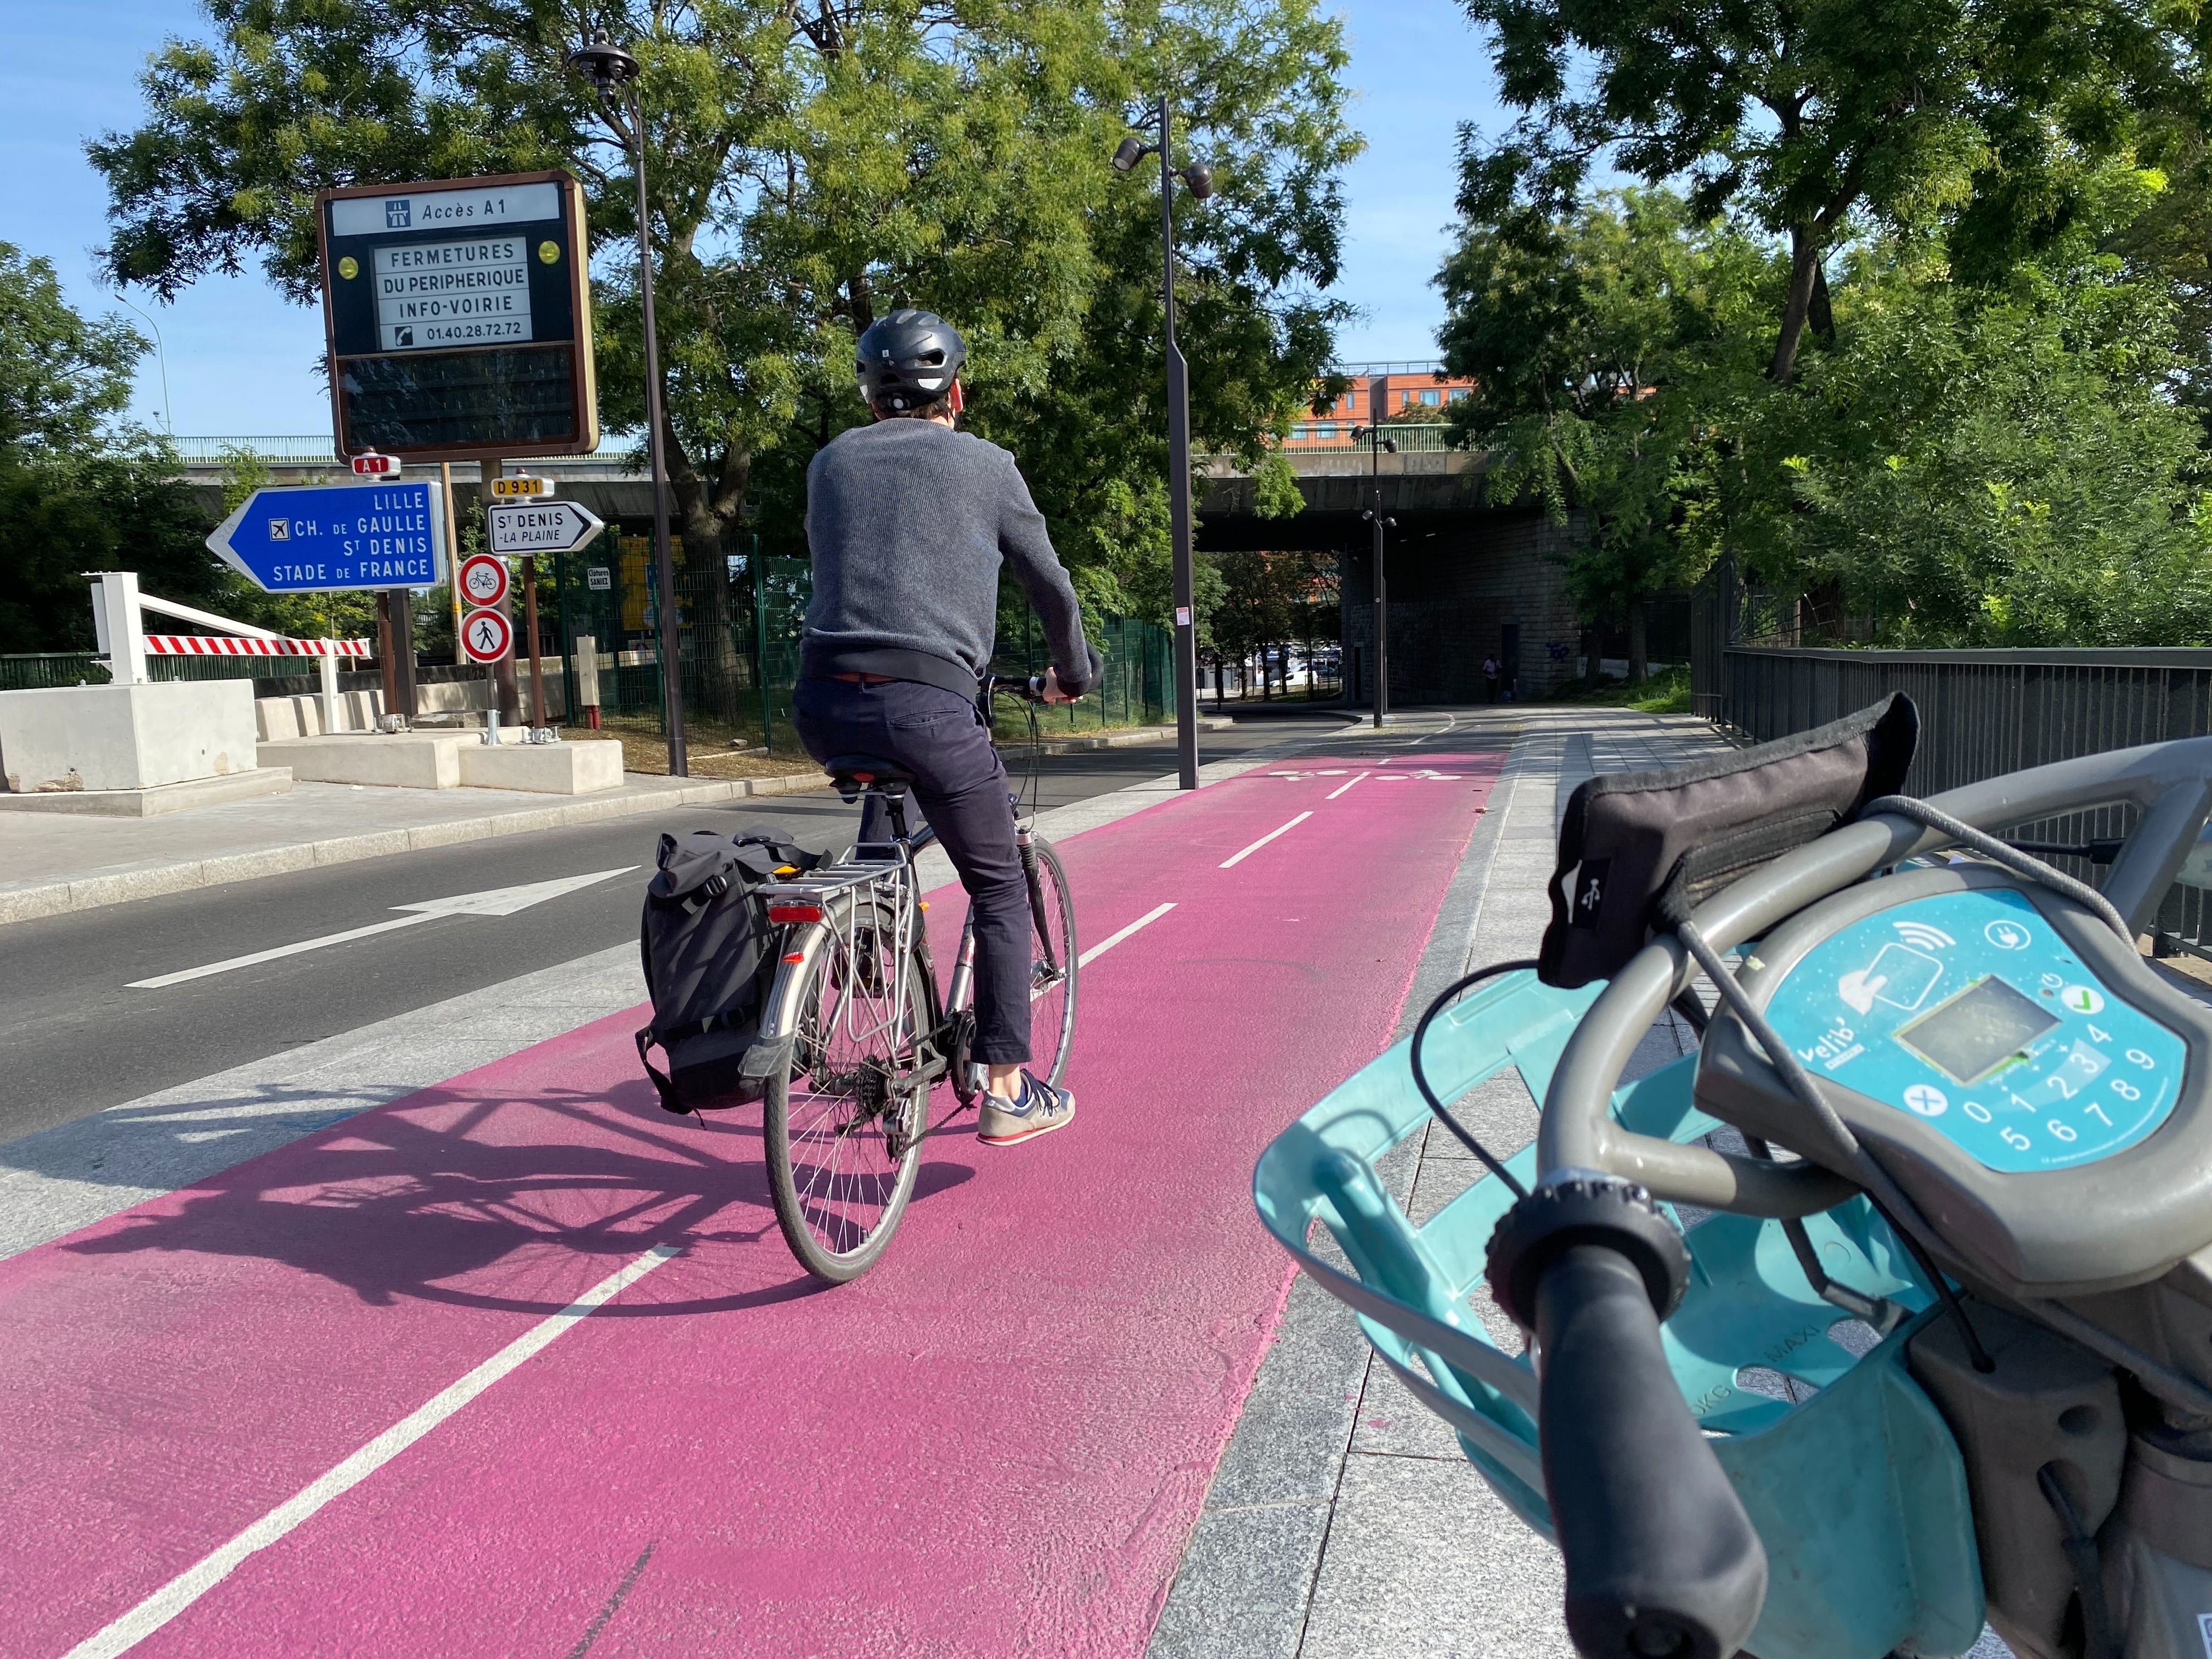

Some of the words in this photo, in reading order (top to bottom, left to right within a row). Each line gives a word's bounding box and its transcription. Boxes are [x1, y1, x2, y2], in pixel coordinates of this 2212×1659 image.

[422, 202, 473, 220] Accès
[391, 243, 514, 267] FERMETURES
[384, 278, 404, 294] DU
[409, 269, 524, 291] PERIPHERIQUE
[400, 296, 512, 318] INFO-VOIRIE
[427, 322, 521, 340] 01.40.28.72.72
[374, 492, 424, 510] LILLE
[295, 520, 323, 537] CH.
[333, 524, 347, 535] DE
[357, 514, 425, 534] GAULLE
[517, 512, 563, 528] DENIS
[370, 537, 427, 555] DENIS
[522, 529, 560, 542] PLAINE
[273, 563, 326, 582] STADE
[336, 568, 350, 579] DE
[359, 558, 428, 578] FRANCE
[588, 568, 609, 577] Clôtures
[590, 577, 608, 586] SANIEZ
[2125, 1048, 2155, 1070] 9
[1962, 1101, 1993, 1124] 0
[2011, 1092, 2037, 1113] 1
[2046, 1076, 2079, 1100] 2
[2068, 1052, 2100, 1074] 3
[2086, 1023, 2113, 1043] 4
[2111, 1079, 2141, 1101] 8
[2084, 1102, 2113, 1127] 7
[2000, 1126, 2031, 1151] 5
[2046, 1119, 2078, 1142] 6
